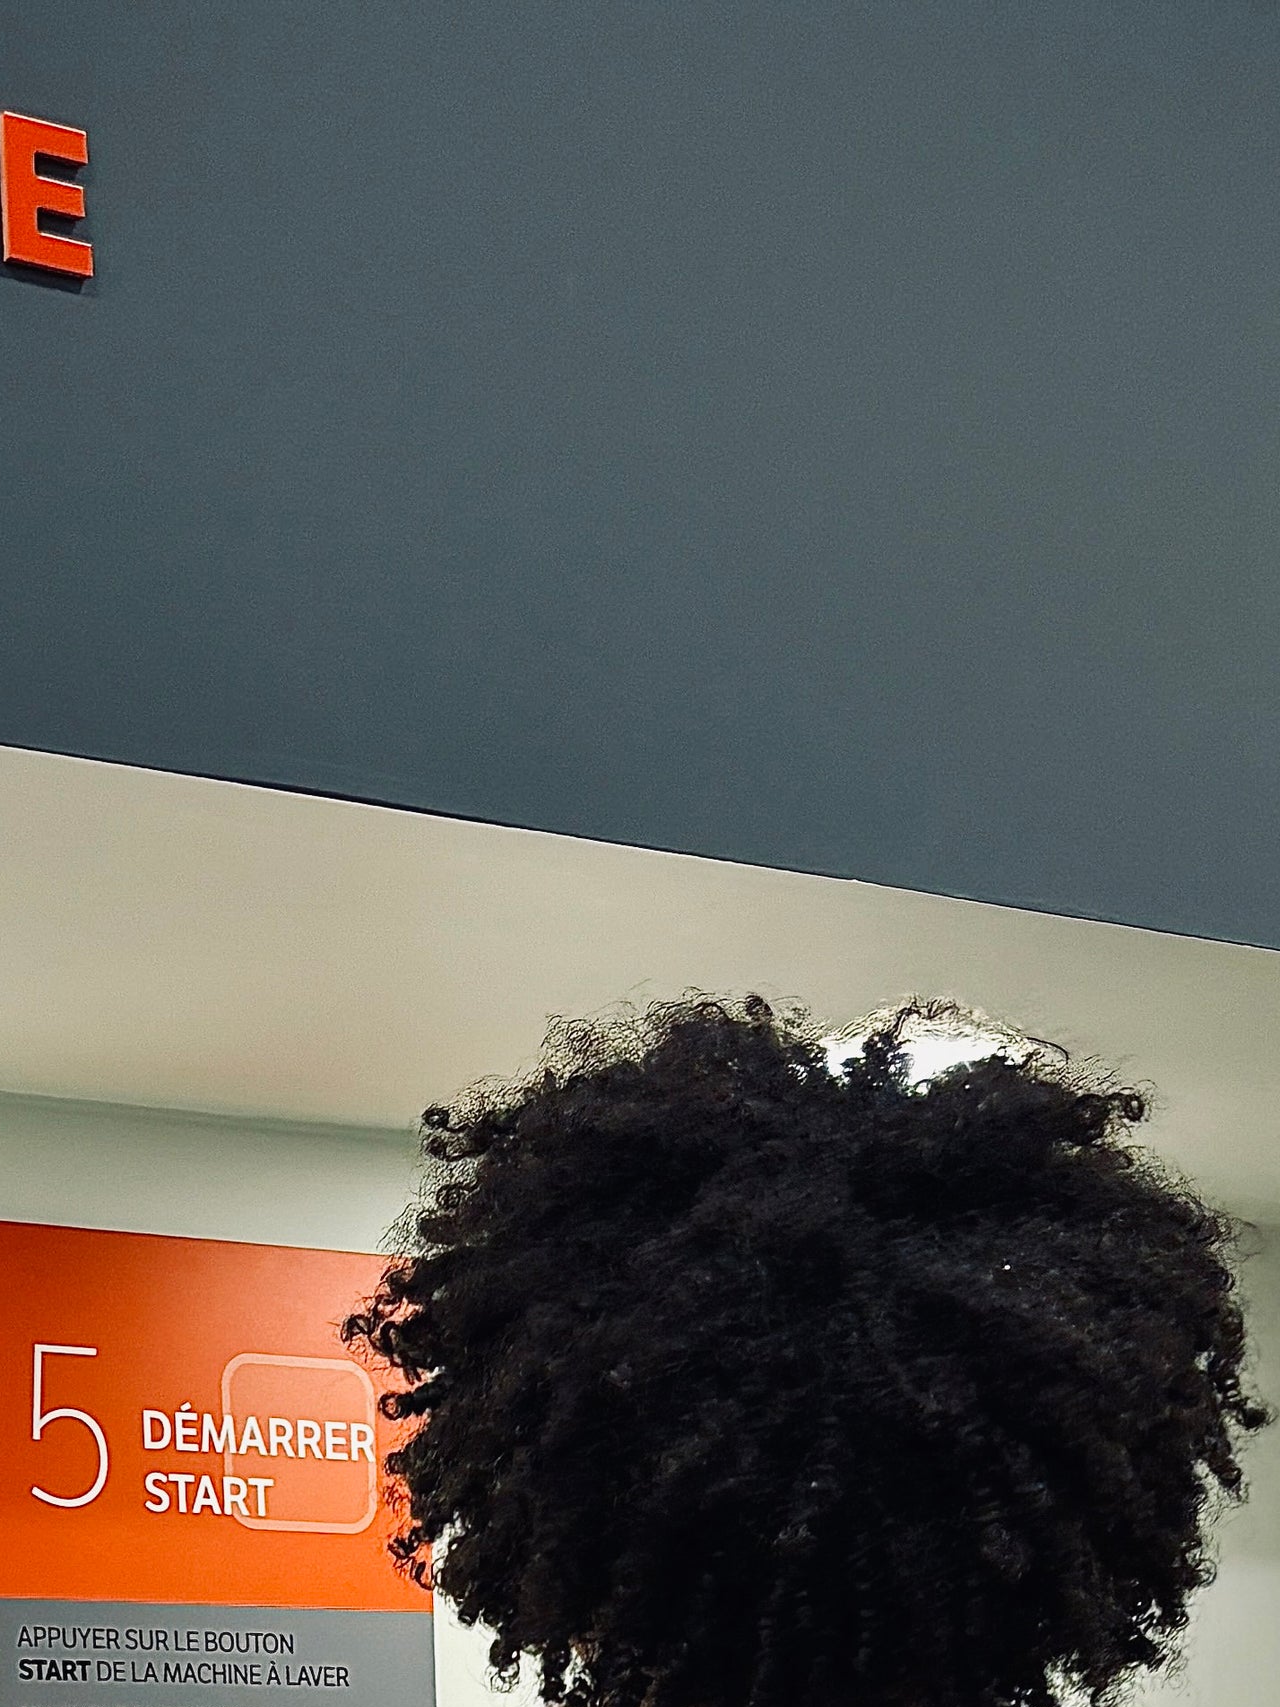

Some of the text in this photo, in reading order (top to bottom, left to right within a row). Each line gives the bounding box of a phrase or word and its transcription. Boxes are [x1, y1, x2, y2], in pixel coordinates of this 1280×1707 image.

[30, 1344, 110, 1509] 5
[141, 1401, 377, 1462] DÉMARRER
[144, 1472, 275, 1518] START
[17, 1626, 295, 1655] APPUYER SUR LE BOUTON
[18, 1658, 350, 1688] START DE LA MACHINE À LAVER
